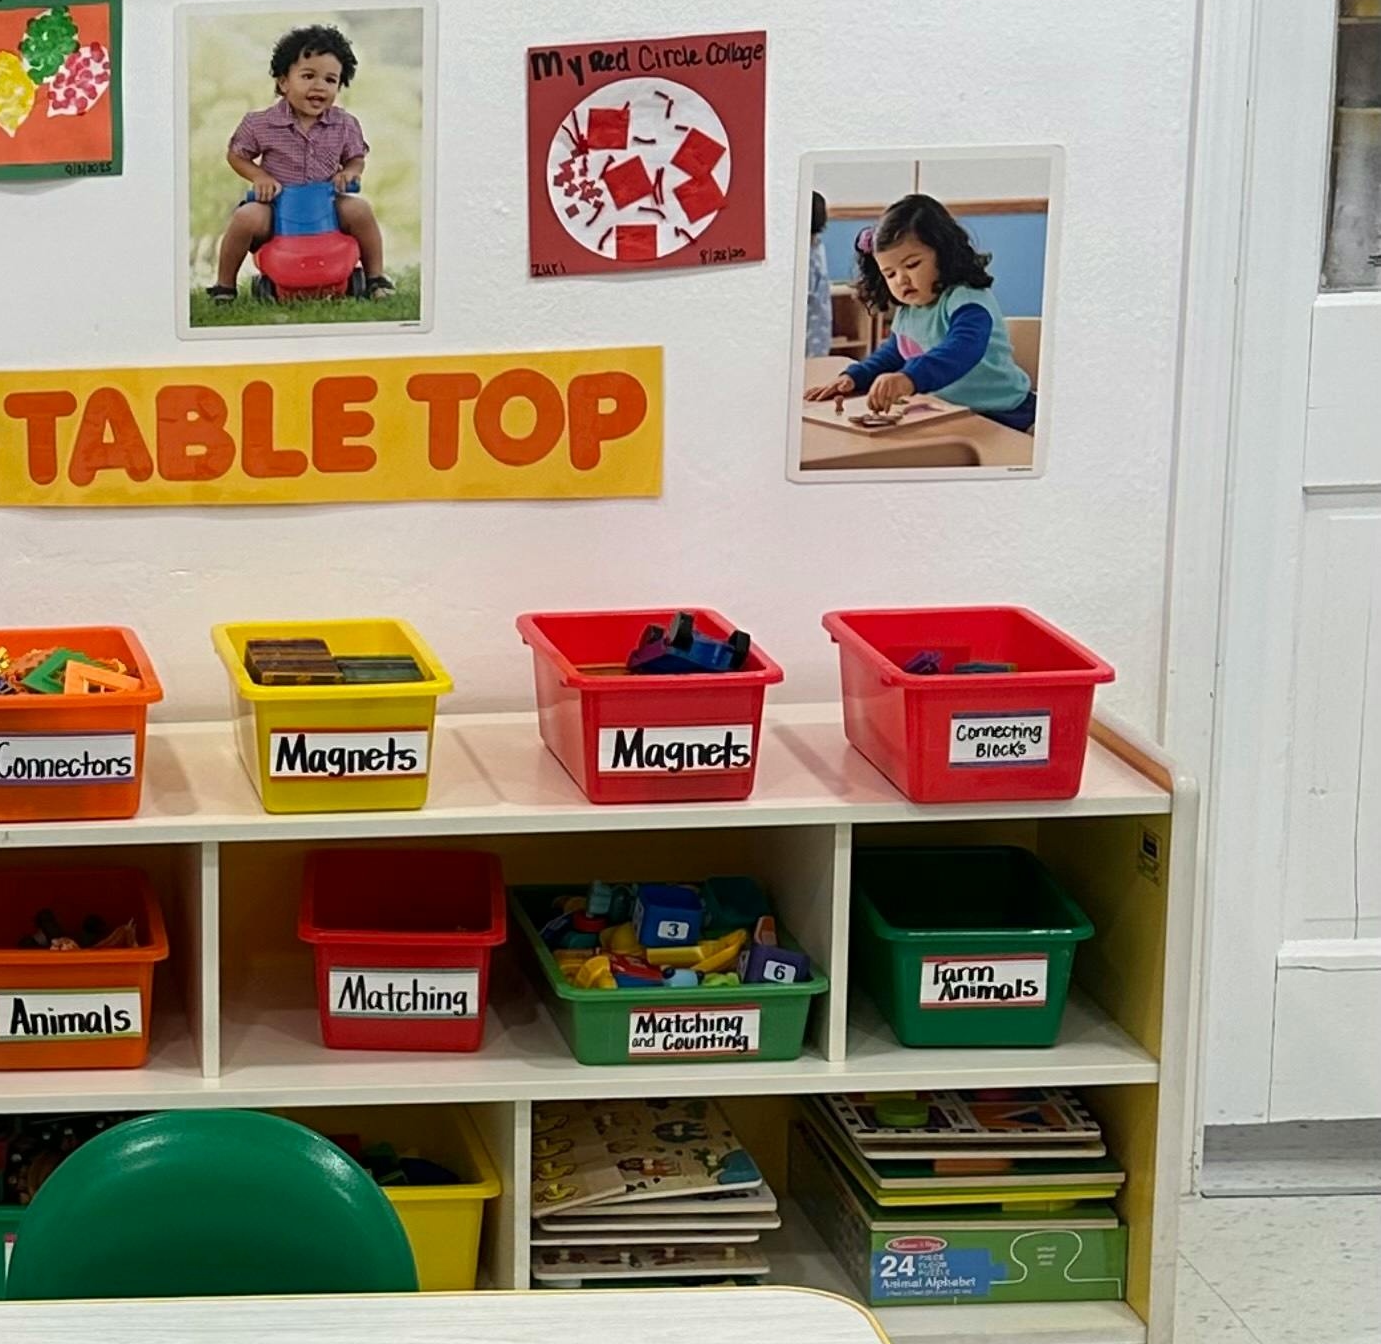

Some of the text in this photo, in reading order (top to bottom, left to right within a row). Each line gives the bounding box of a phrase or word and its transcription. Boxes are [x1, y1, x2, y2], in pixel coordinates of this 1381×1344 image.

[3, 367, 648, 487] TABLE TOP
[956, 722, 1043, 744] Connecting
[275, 733, 418, 777] Magnets
[611, 727, 751, 773] Magnets
[667, 923, 679, 936] 3
[774, 965, 786, 980] 6
[933, 963, 994, 985] Farm
[337, 973, 468, 1017] Matching
[937, 977, 1039, 1001] Animals
[9, 996, 132, 1035] Animals
[635, 1012, 744, 1036] Matching
[631, 1031, 748, 1053] and Counting
[880, 1254, 916, 1278] 24
[882, 1275, 976, 1290] Animal Alphabet
